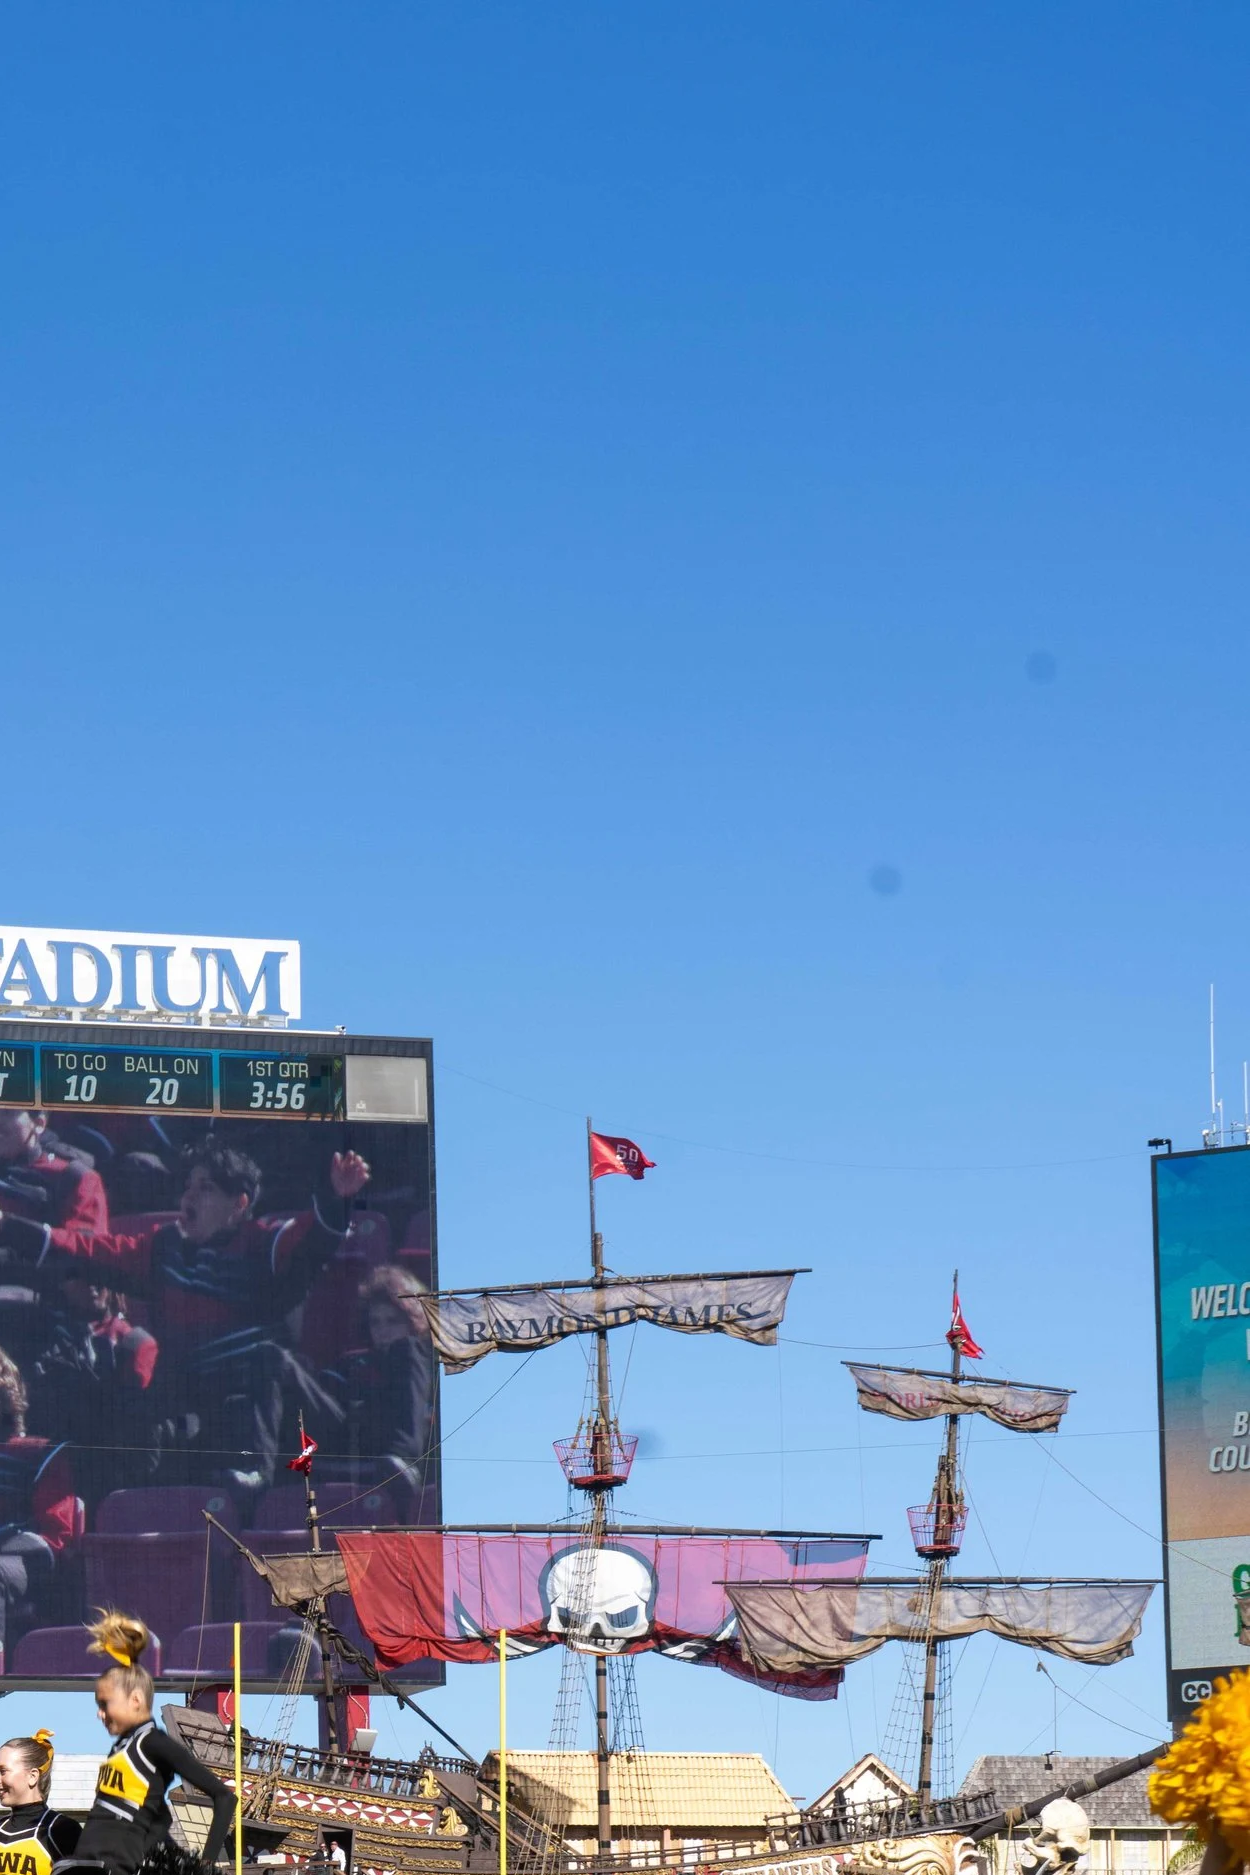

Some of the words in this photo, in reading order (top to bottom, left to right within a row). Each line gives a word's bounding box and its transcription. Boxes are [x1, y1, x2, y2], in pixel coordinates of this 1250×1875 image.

[54, 1053, 77, 1071] TO
[83, 1055, 107, 1071] GO
[124, 1056, 168, 1074] BALL
[174, 1058, 199, 1075] ON
[247, 1061, 275, 1078] 1ST
[279, 1062, 309, 1079] QTR
[63, 1074, 97, 1102] 10
[146, 1077, 179, 1105] 20
[250, 1081, 306, 1110] 3:56
[1183, 1683, 1211, 1701] CC
